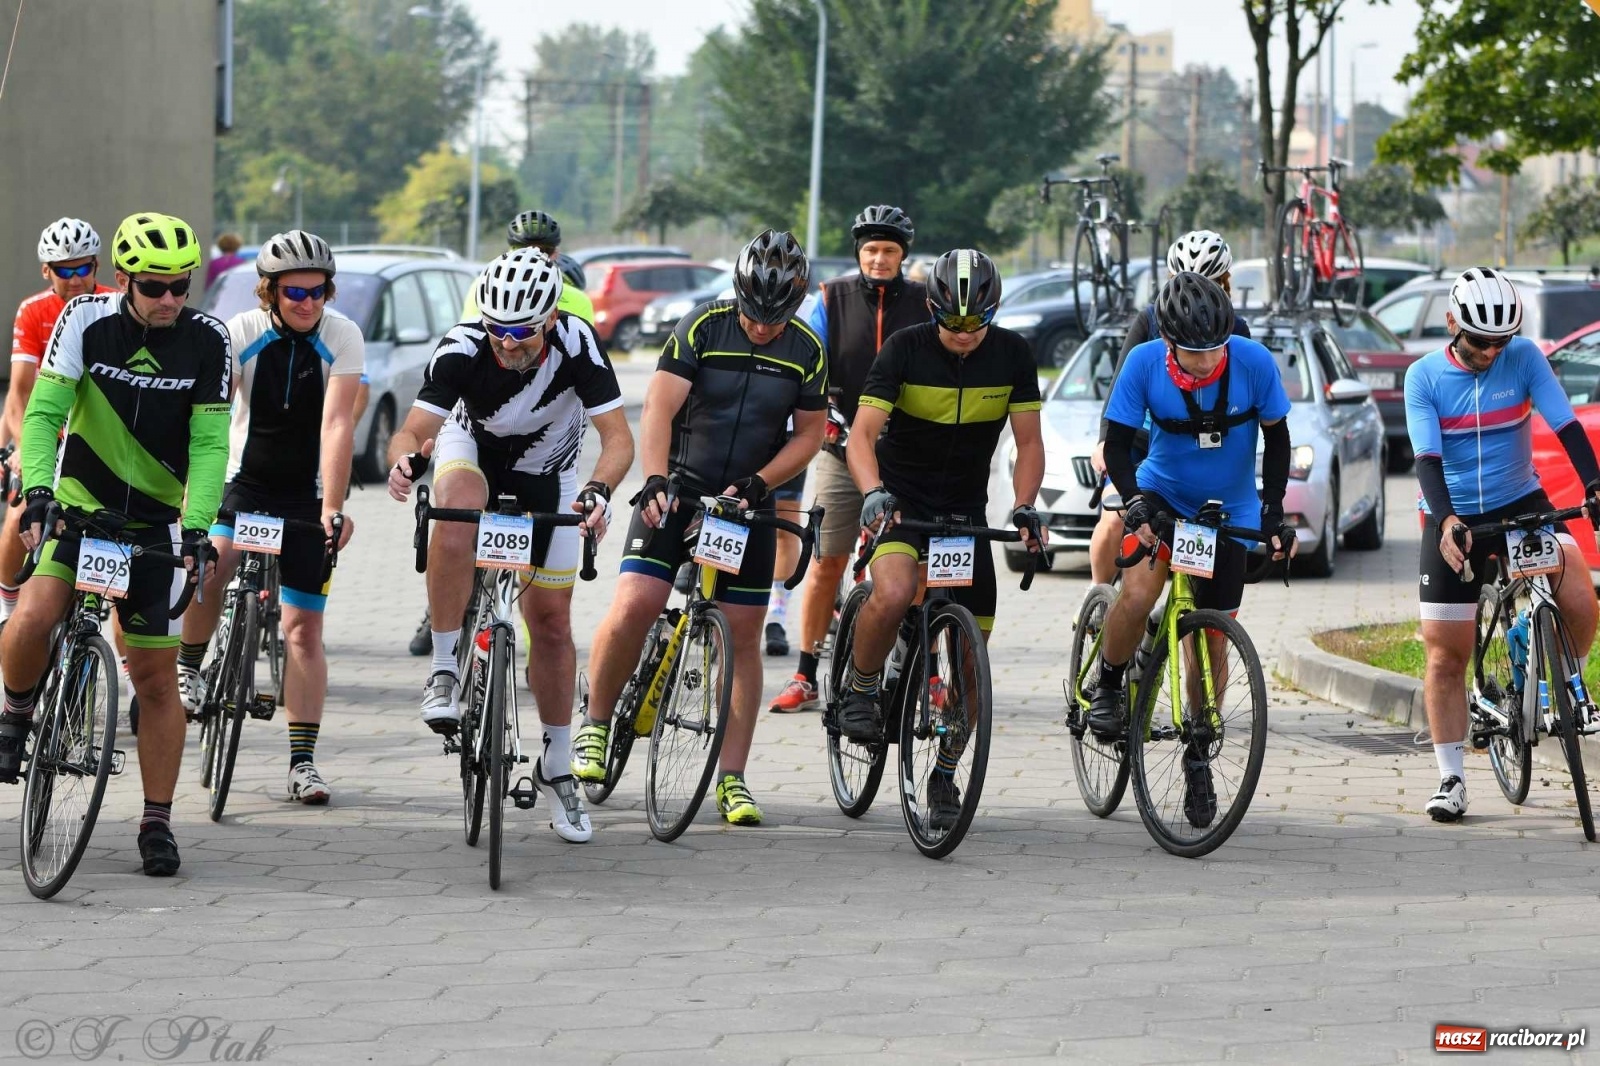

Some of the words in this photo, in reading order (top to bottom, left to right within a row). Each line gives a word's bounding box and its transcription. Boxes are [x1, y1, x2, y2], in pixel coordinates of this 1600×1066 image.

[48, 295, 110, 367] MERIDA
[89, 362, 196, 390] MERIDA
[1492, 389, 1515, 400] more
[238, 524, 281, 540] 2097
[482, 531, 530, 550] 2089
[702, 532, 743, 556] 1465
[1176, 538, 1213, 559] 2094
[82, 554, 127, 577] 2095
[931, 552, 971, 568] 2092
